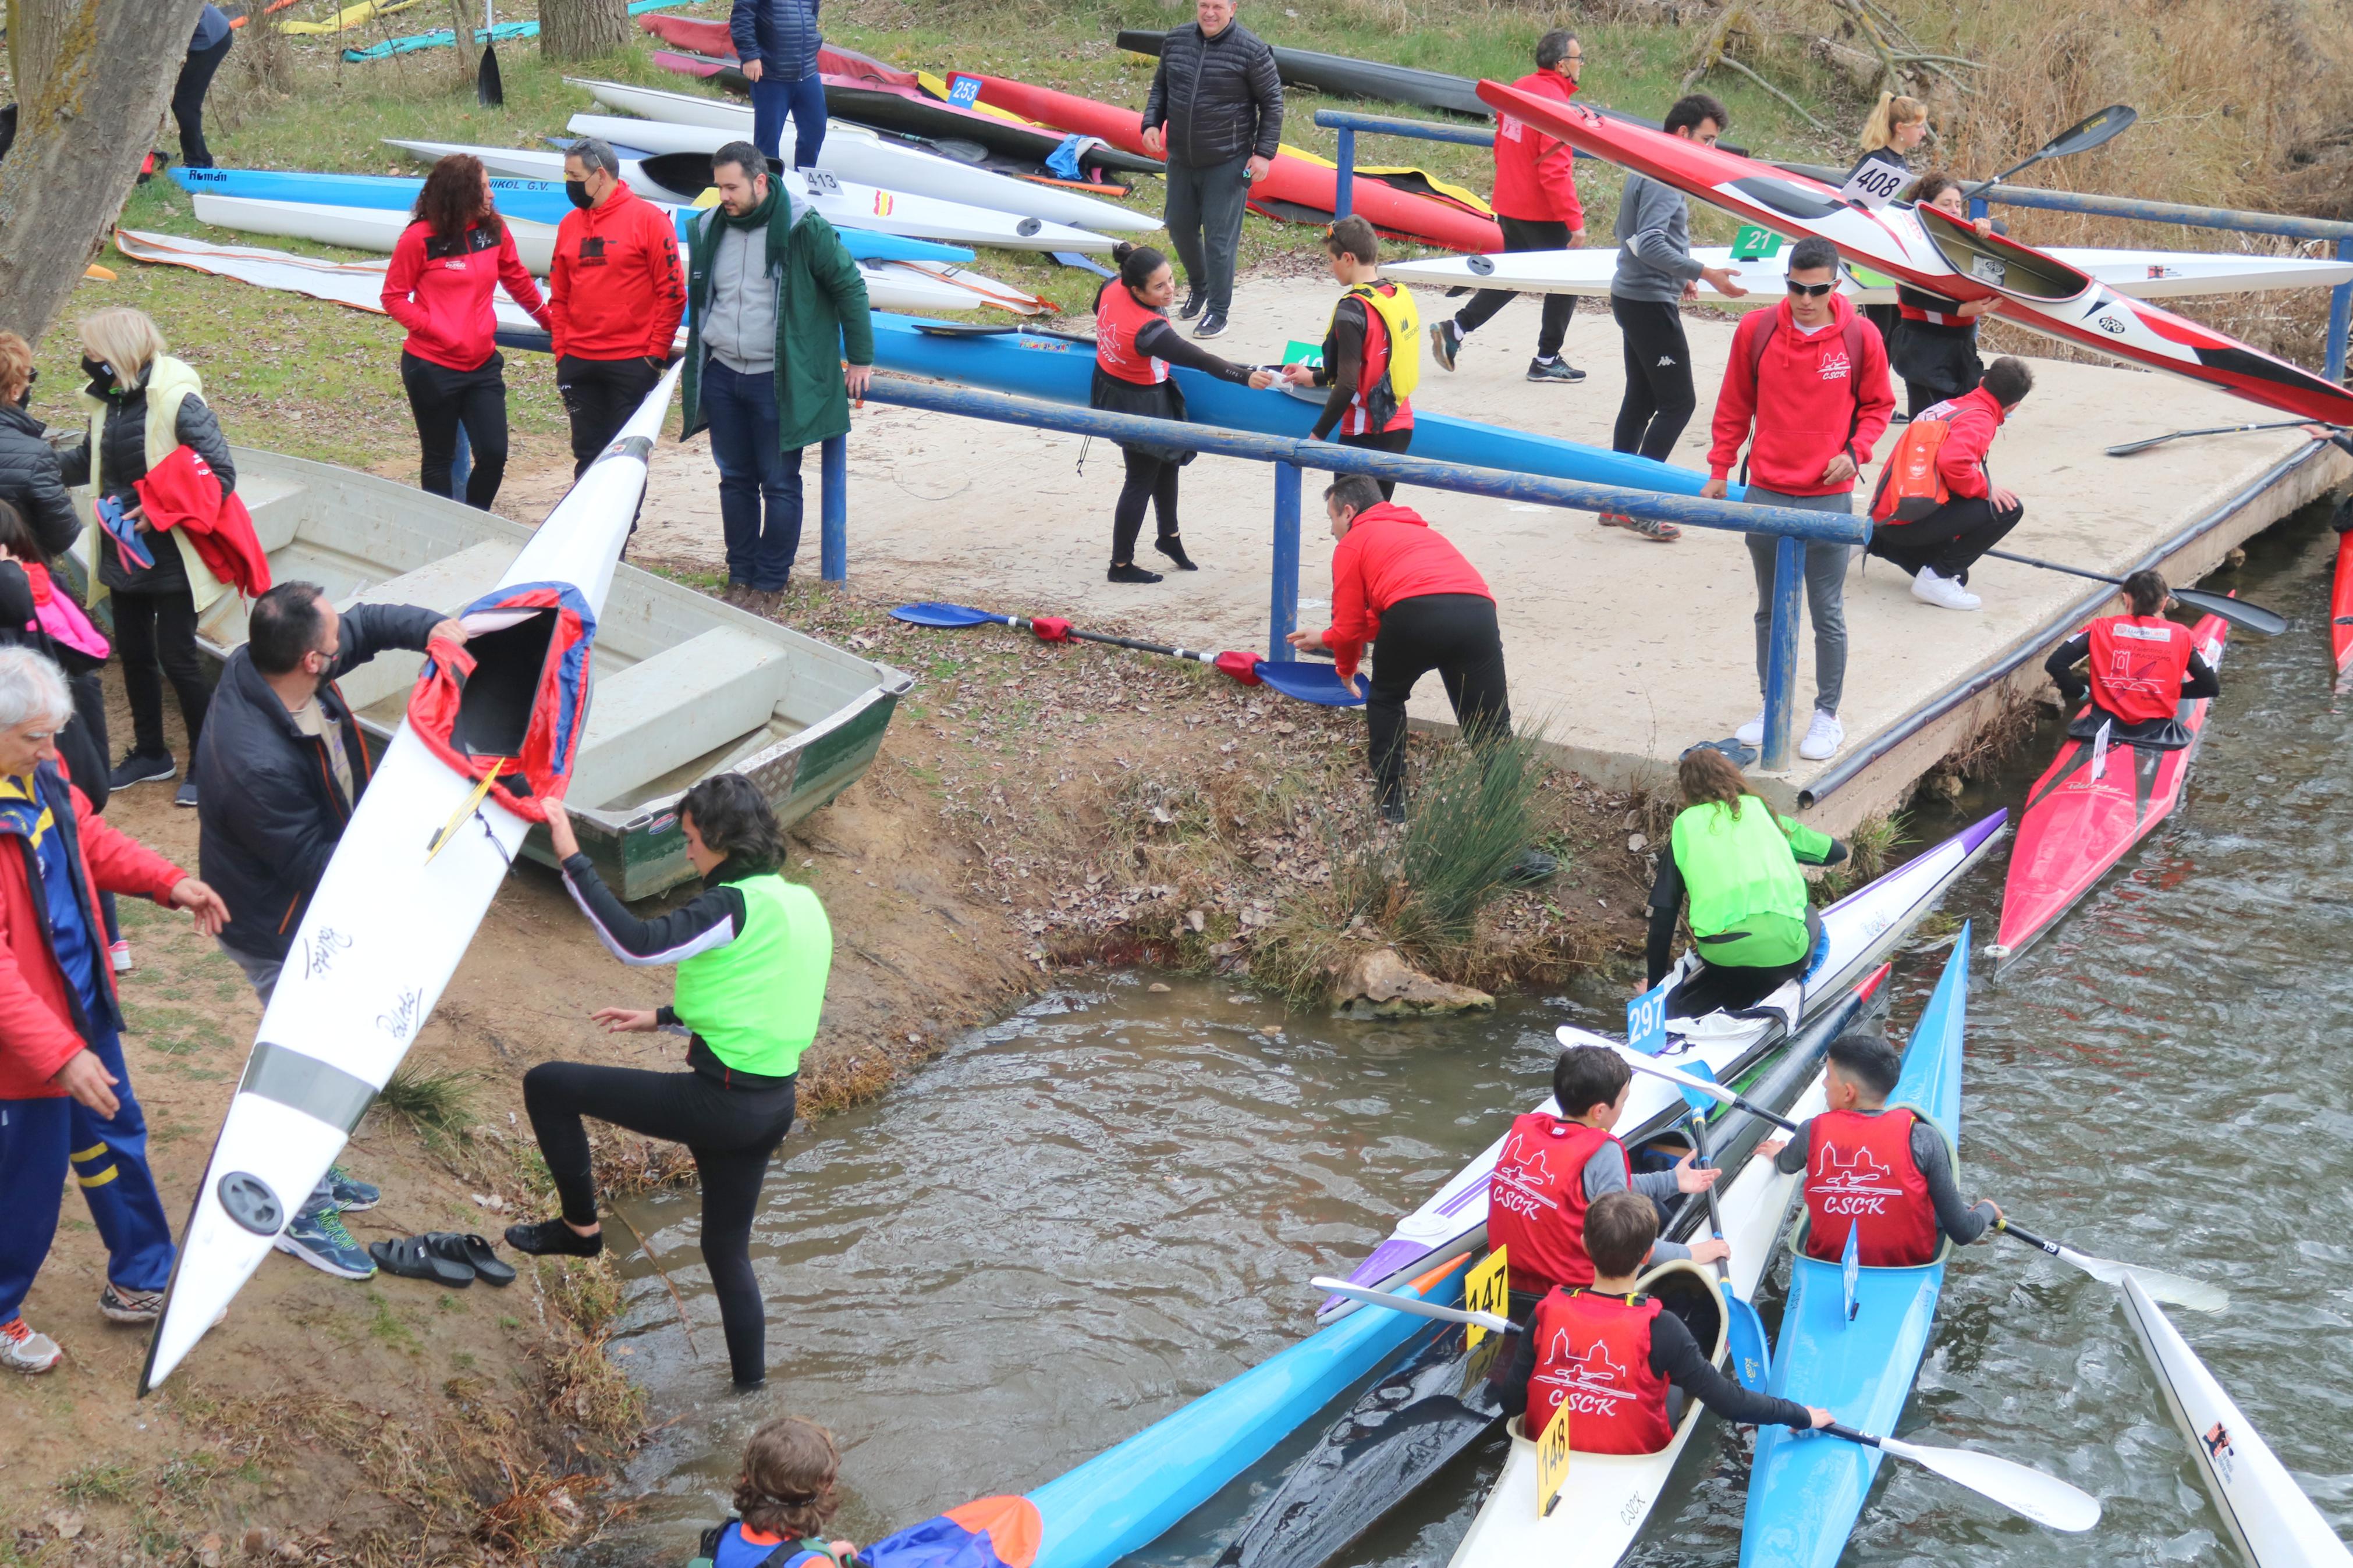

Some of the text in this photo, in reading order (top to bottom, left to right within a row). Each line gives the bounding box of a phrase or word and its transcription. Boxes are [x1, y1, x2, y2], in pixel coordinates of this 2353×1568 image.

[952, 81, 977, 101] 253
[189, 169, 227, 182] Román
[807, 172, 837, 189] 413
[1857, 168, 1900, 198] 408
[527, 182, 548, 191] G.V.
[1744, 230, 1772, 250] 21
[1822, 370, 1847, 381] CSCK
[1629, 993, 1664, 1046] 297
[1493, 1185, 1541, 1221] CSCK
[1824, 1196, 1886, 1215] CSCK
[2043, 1240, 2057, 1253] 19
[1468, 1265, 1506, 1329] 147
[1549, 1389, 1617, 1417] CSCK
[1542, 1418, 1566, 1487] 148
[1620, 1490, 1646, 1526] CSCK
